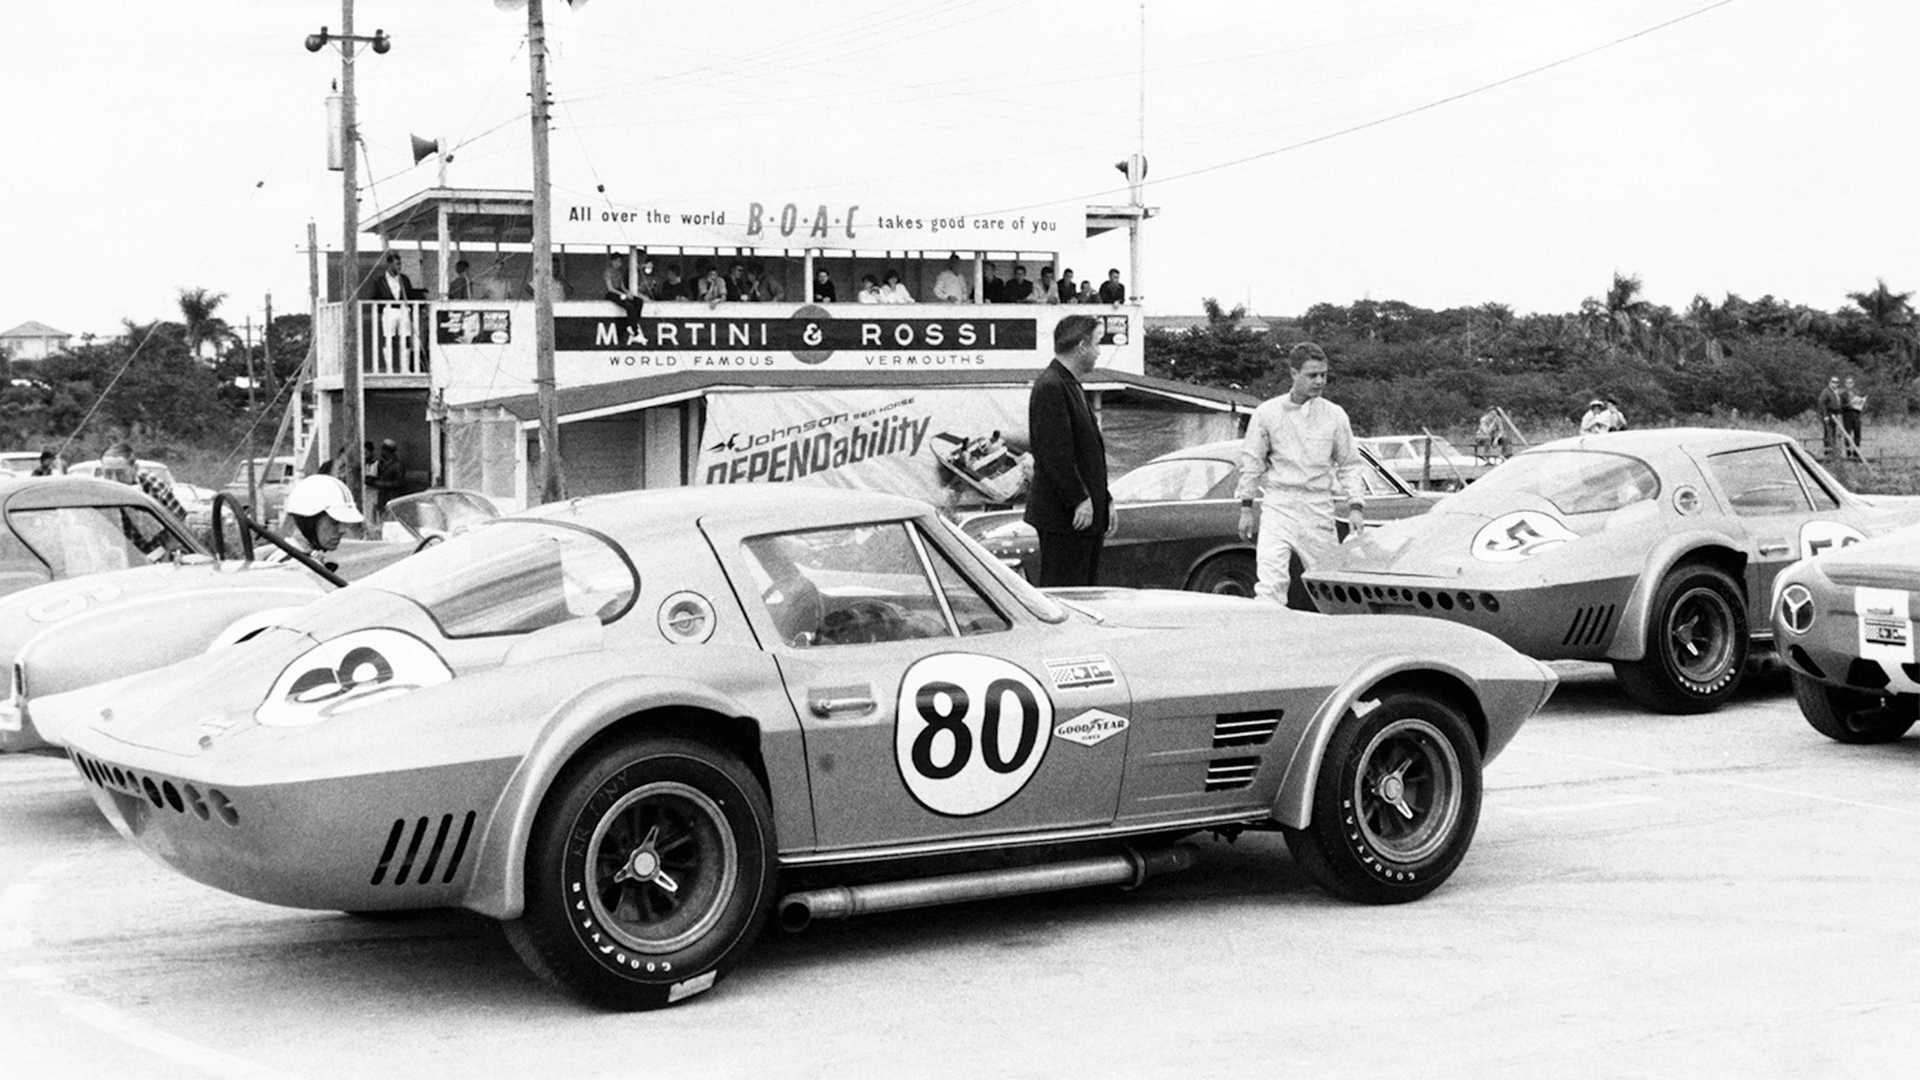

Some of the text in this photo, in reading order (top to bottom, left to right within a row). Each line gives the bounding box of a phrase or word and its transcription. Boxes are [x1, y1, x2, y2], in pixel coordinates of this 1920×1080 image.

[569, 206, 591, 222] All
[602, 211, 638, 223] over
[647, 208, 671, 224] the
[681, 211, 725, 226] world
[878, 215, 923, 230] takes
[931, 215, 965, 233] good
[974, 218, 1004, 230] care
[1012, 215, 1025, 230] of
[1032, 220, 1057, 234] you
[595, 322, 996, 346] MARTINI & ROSSI
[610, 354, 985, 367] WORLD FAMOUS VERMOUTHS
[706, 414, 932, 484] DEPENDability
[734, 411, 850, 453] Johnson
[911, 678, 1040, 780] 80
